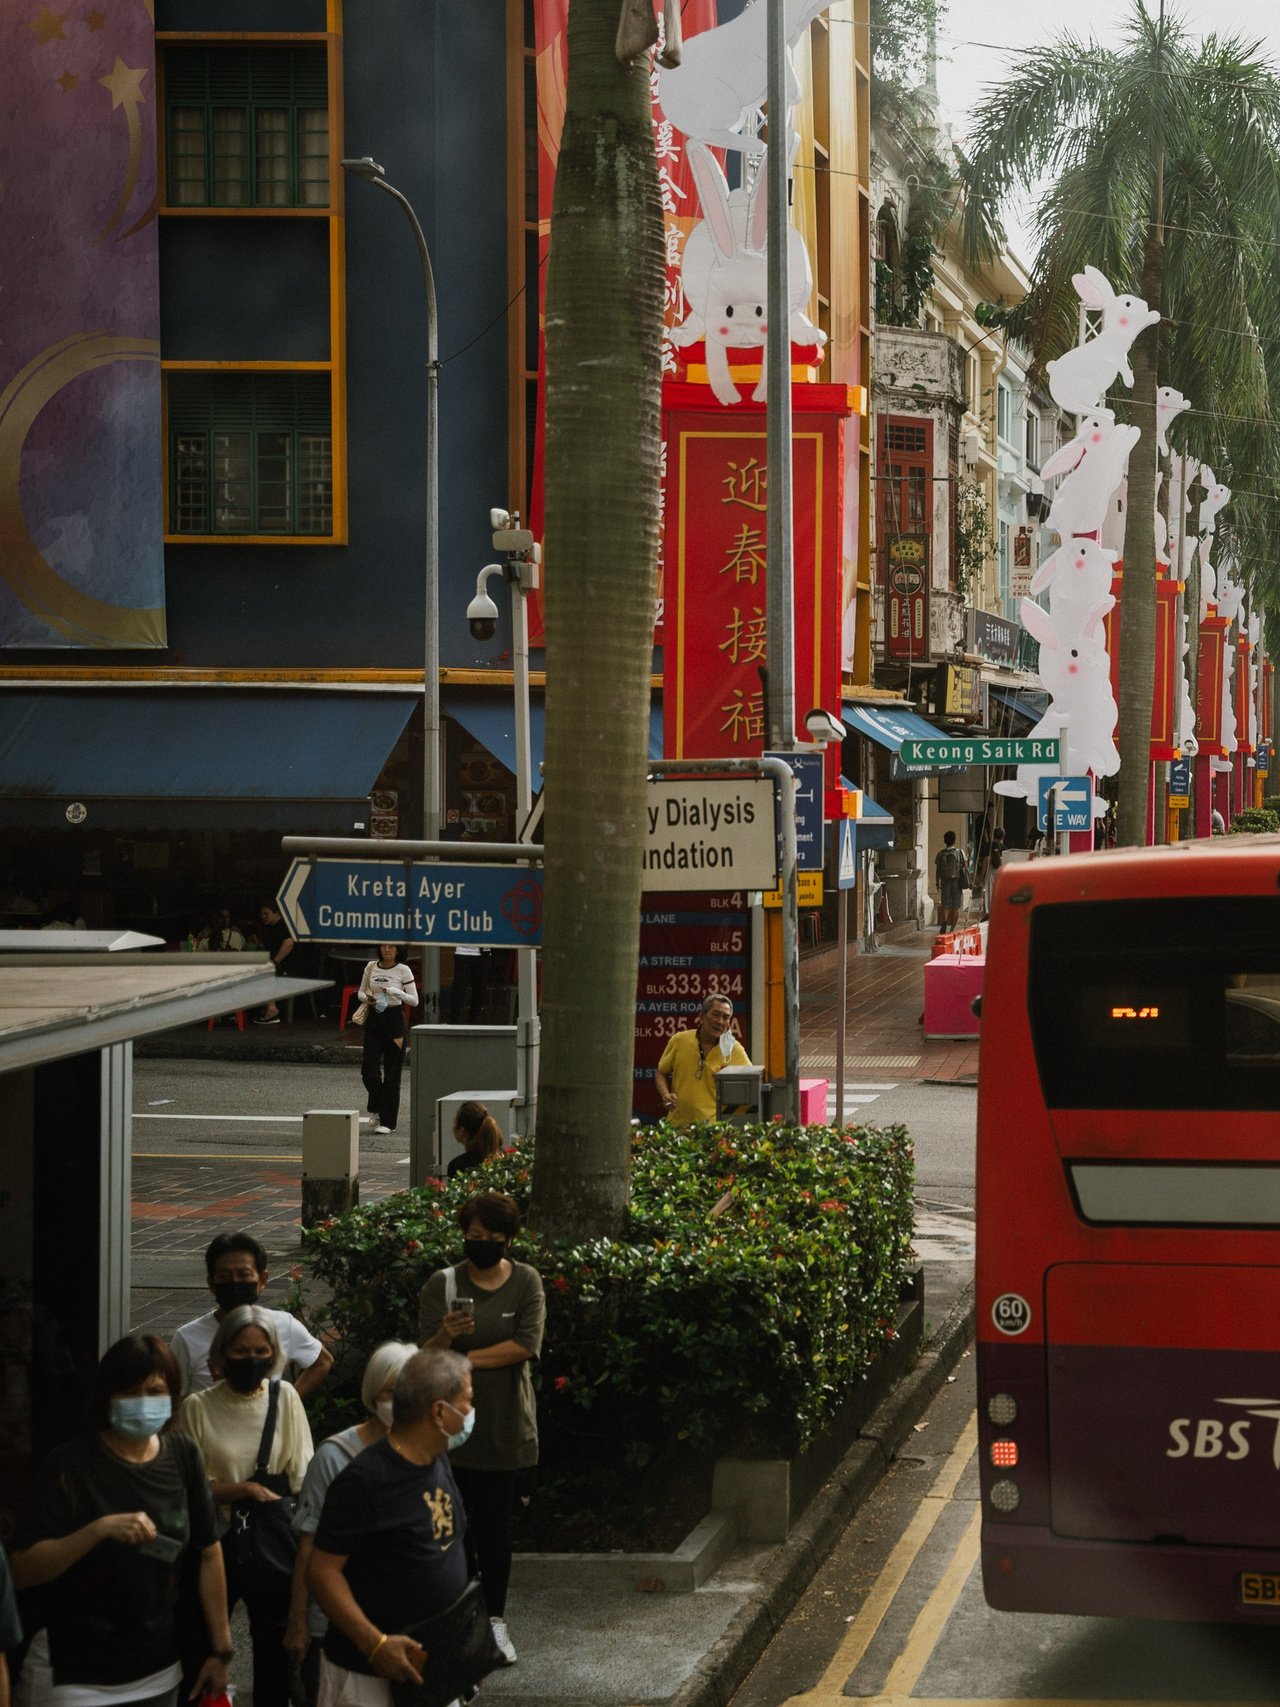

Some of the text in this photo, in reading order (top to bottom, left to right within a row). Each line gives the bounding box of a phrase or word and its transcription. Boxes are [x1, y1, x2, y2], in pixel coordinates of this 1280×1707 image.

[912, 742, 1055, 762] Keong Saik Rd
[666, 796, 755, 831] Dialysis
[1042, 814, 1087, 826] OE WAY
[348, 874, 466, 904] Kreta Ayer
[710, 891, 743, 909] BLK 4
[318, 905, 493, 936] Community Club
[646, 914, 676, 924] LANE
[710, 932, 743, 952] BLK 5
[651, 957, 694, 966] STREET
[646, 974, 743, 998] BLK 333,334
[649, 1002, 677, 1012] AYER
[680, 1002, 703, 1012] ROA
[1000, 1300, 1023, 1318] 60
[1000, 1319, 1023, 1327] km/h
[1166, 1418, 1251, 1460] SBS
